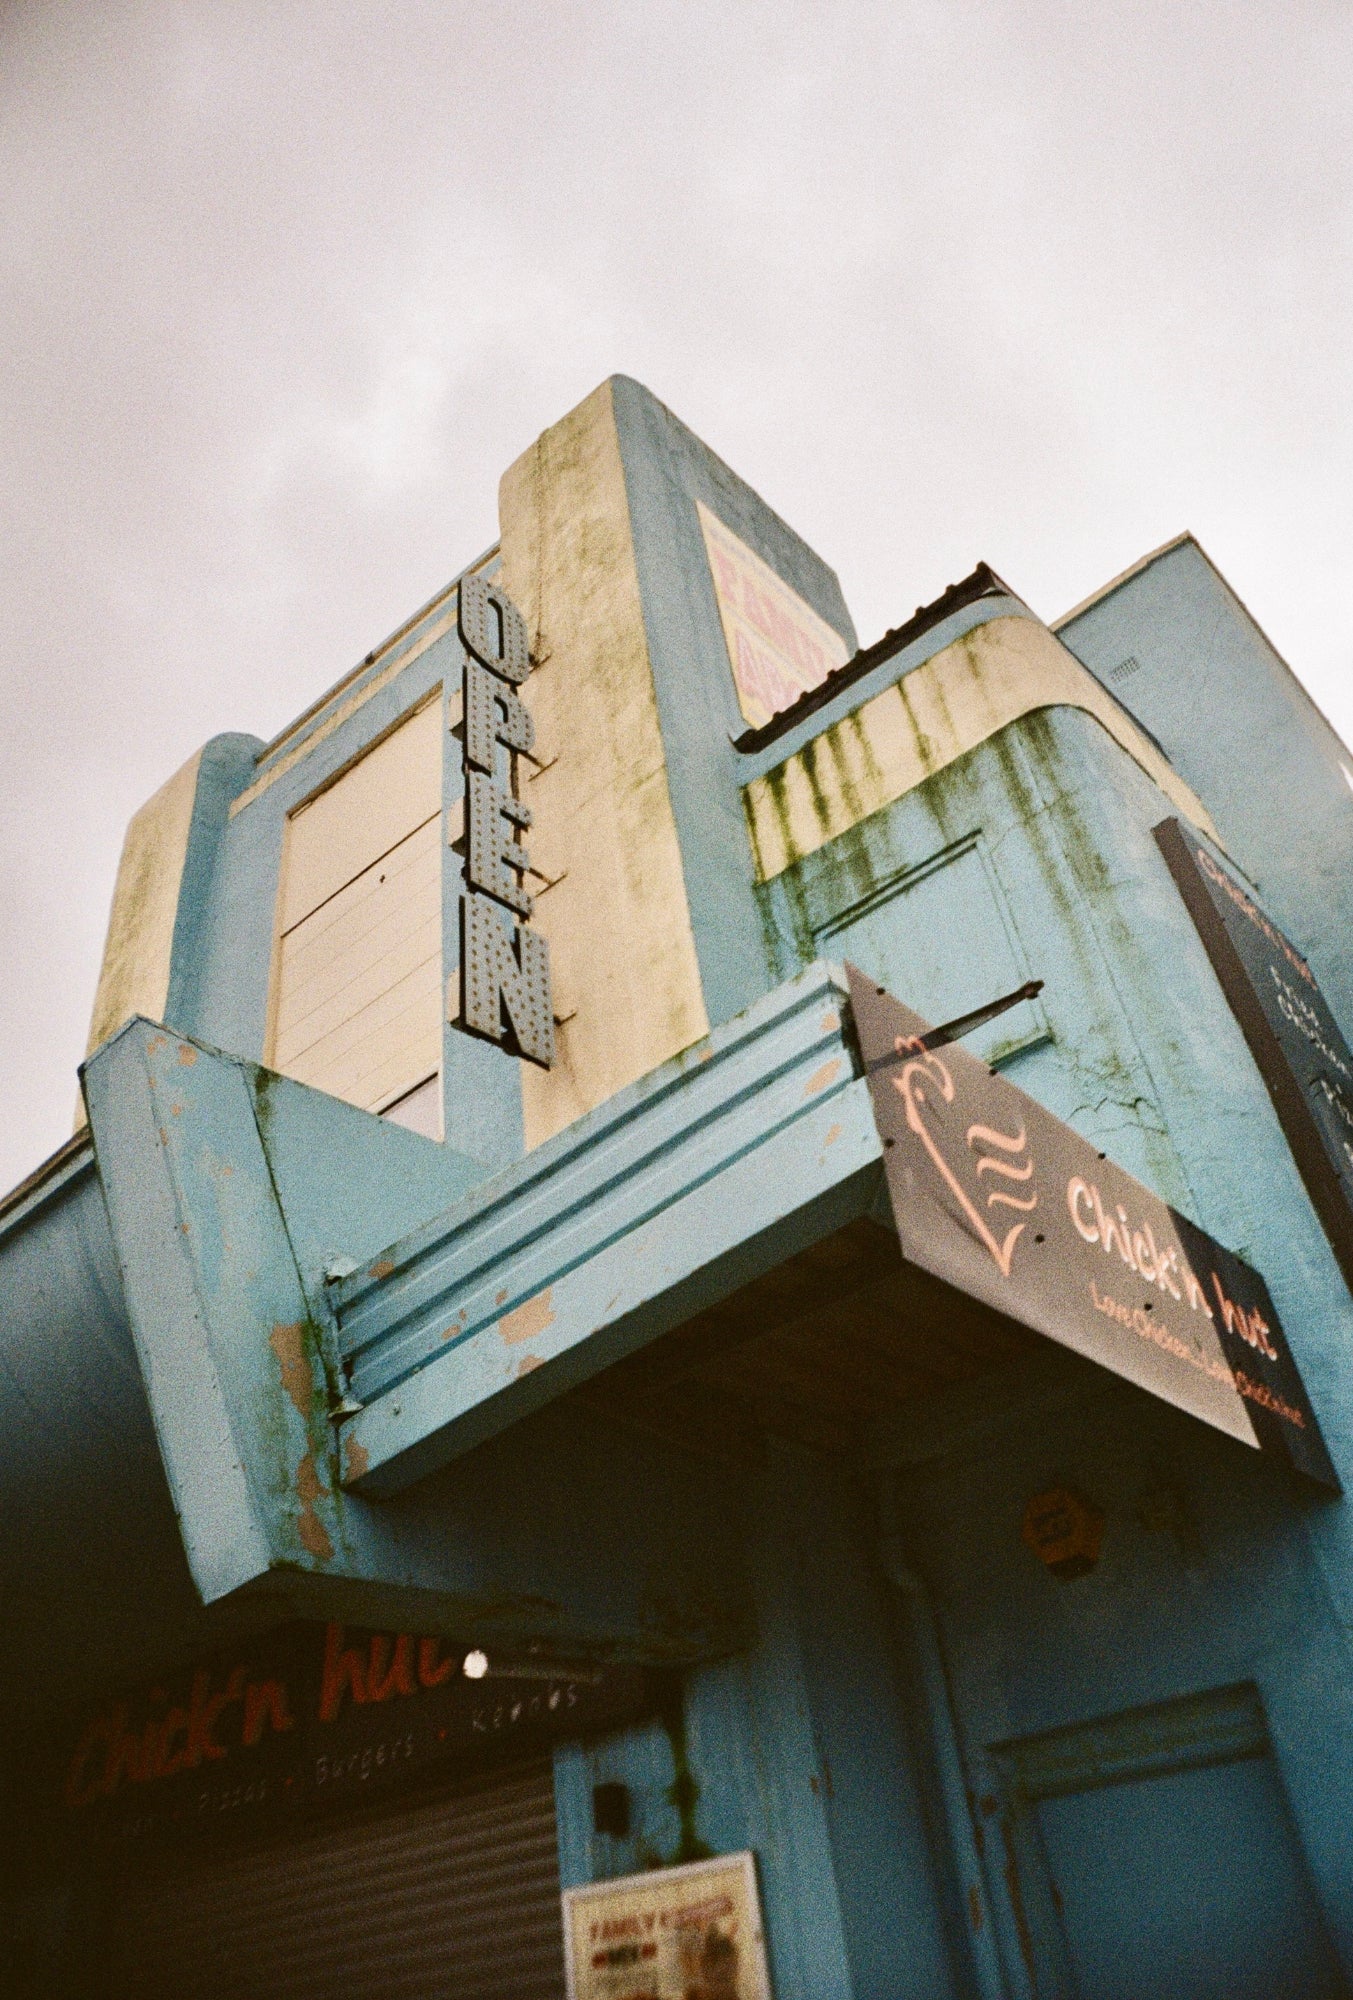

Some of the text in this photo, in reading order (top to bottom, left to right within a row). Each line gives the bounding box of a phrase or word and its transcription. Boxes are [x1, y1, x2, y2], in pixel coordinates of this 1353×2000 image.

[458, 575, 557, 1071] OPEN
[1067, 1175, 1278, 1361] Chick'n hut
[315, 1732, 416, 1786] Burgers
